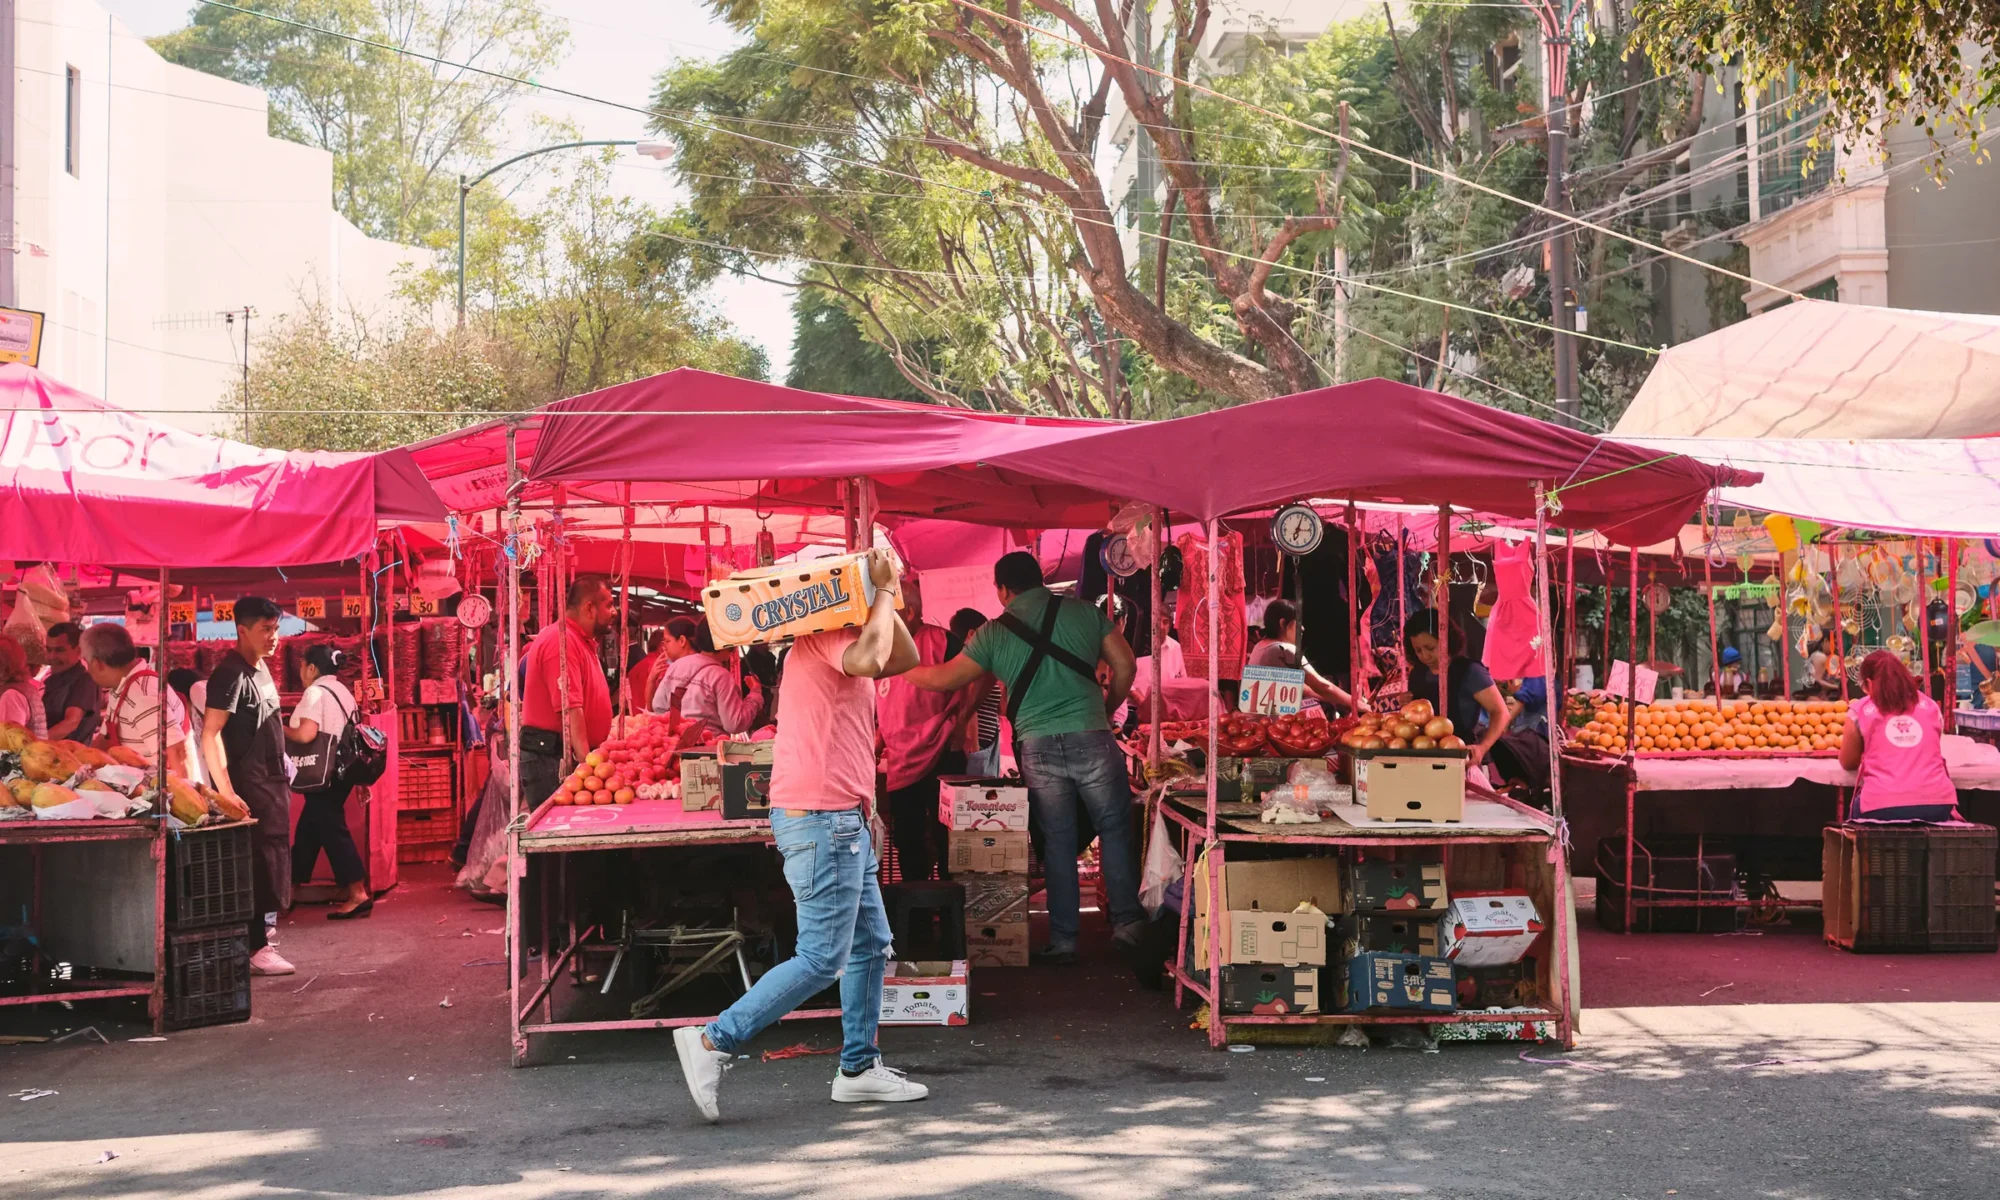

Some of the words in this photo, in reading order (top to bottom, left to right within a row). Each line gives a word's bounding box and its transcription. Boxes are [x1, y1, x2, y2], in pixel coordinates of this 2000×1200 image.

[346, 604, 360, 616] 40
[419, 601, 433, 613] 50
[751, 577, 850, 632] CRYSTAL
[171, 610, 187, 623] 35
[216, 610, 232, 621] 35
[302, 607, 316, 617] 40
[1280, 705, 1296, 714] KILO
[965, 800, 1017, 812] Tomatoes
[902, 1001, 941, 1015] Tomates
